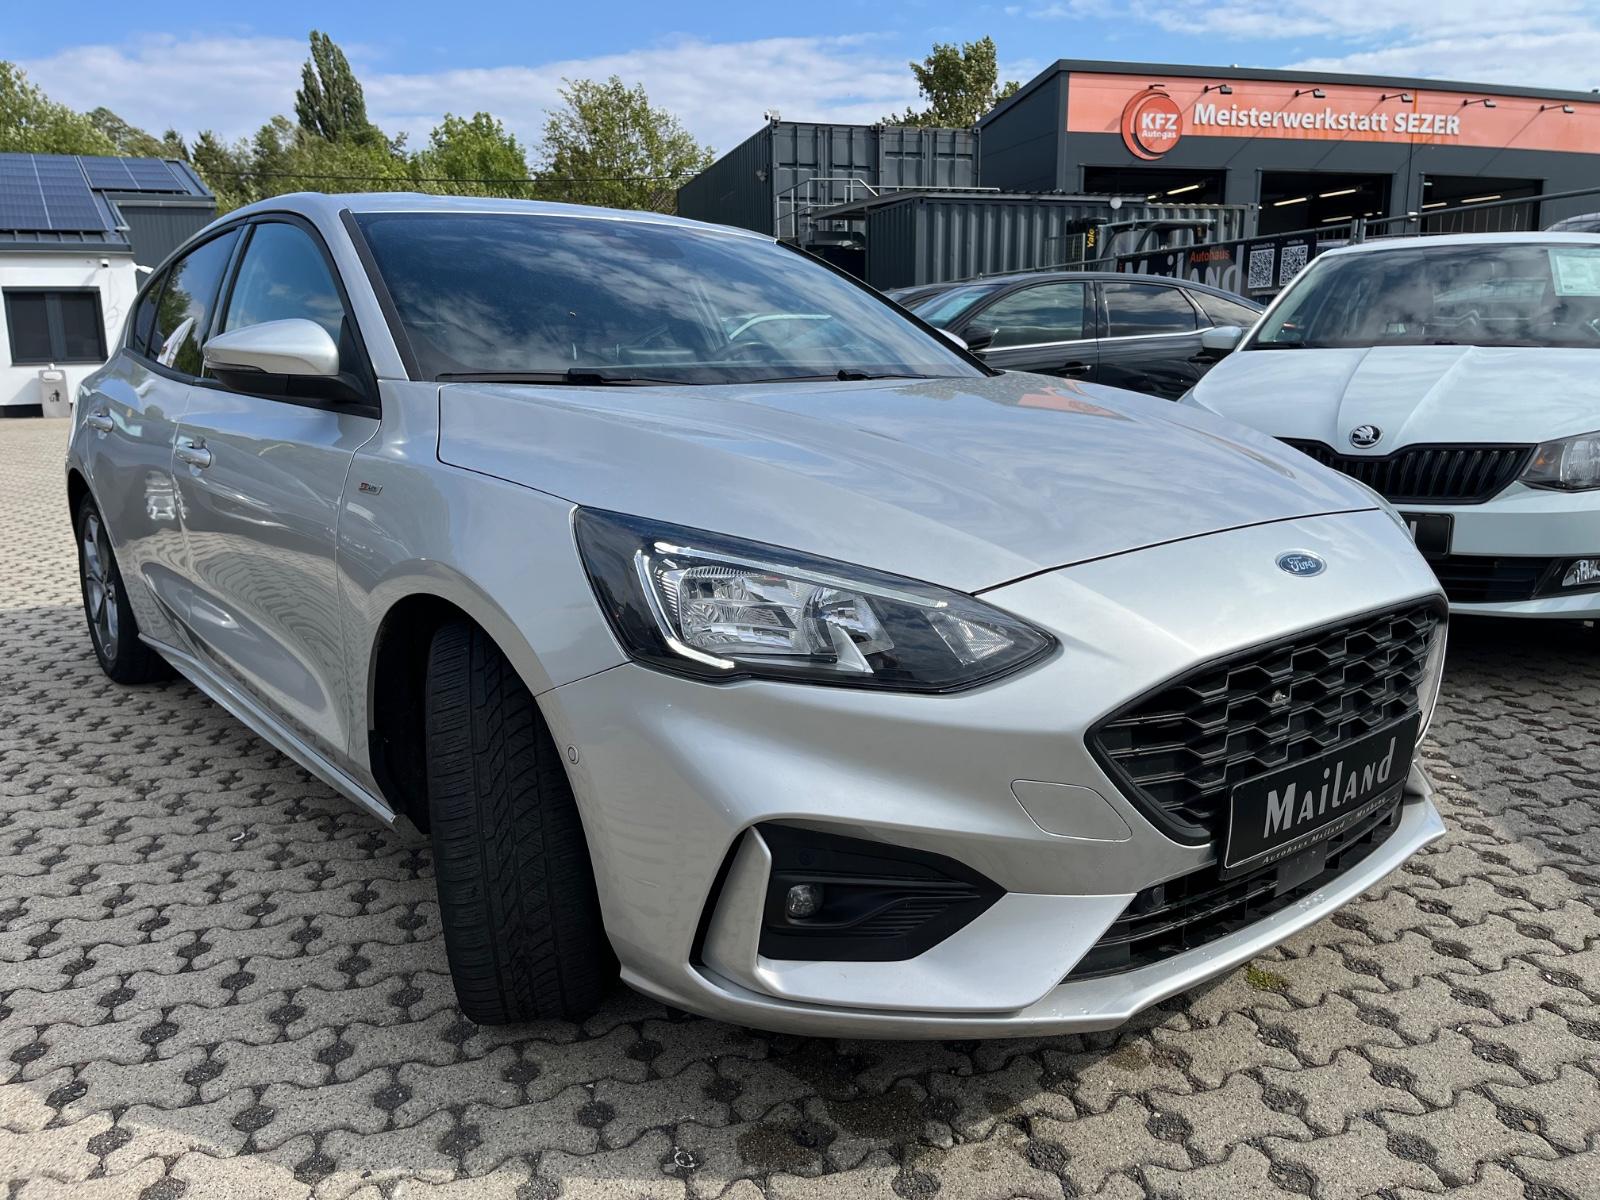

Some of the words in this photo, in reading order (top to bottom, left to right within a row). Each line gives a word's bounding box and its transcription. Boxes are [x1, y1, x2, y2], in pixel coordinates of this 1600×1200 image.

[1141, 112, 1178, 130] KFZ
[1193, 103, 1389, 132] Meisterwerkstatt
[1394, 112, 1461, 135] SEZER
[1141, 129, 1177, 140] Autogas
[1190, 247, 1231, 264] Autohaus
[1287, 556, 1317, 571] Ford
